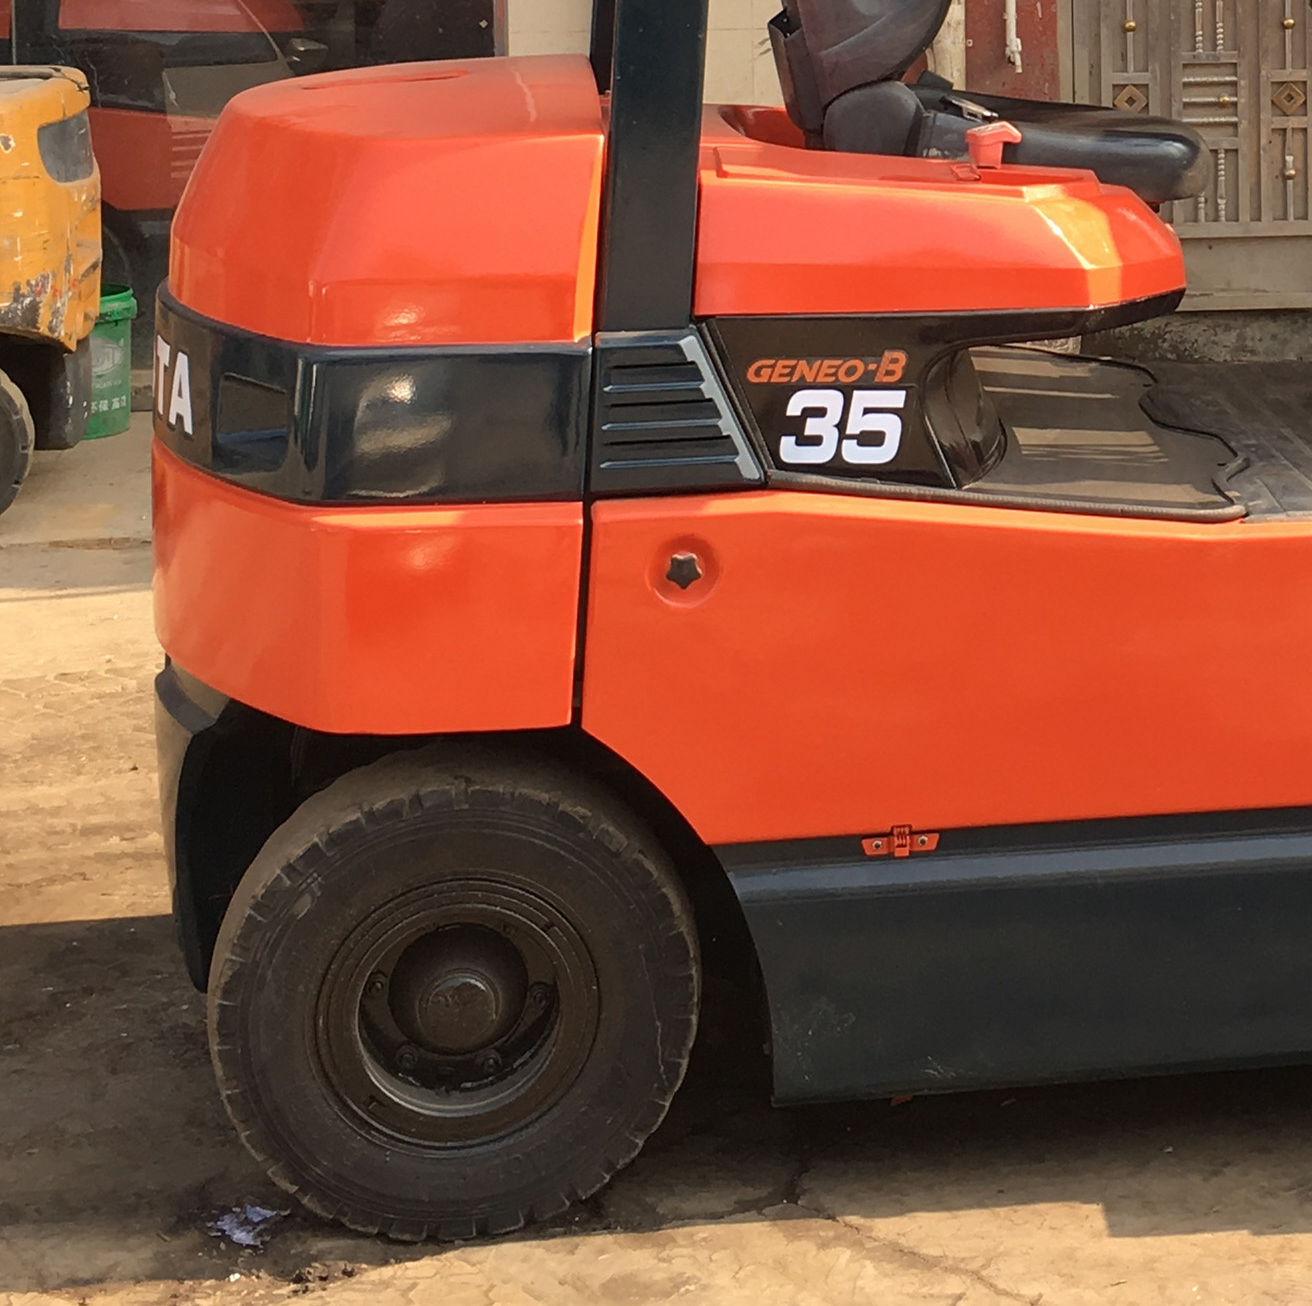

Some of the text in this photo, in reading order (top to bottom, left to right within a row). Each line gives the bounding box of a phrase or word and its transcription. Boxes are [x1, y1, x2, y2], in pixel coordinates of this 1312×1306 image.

[157, 334, 193, 436] TA
[746, 350, 907, 384] GENEO-B
[779, 389, 906, 464] 35
